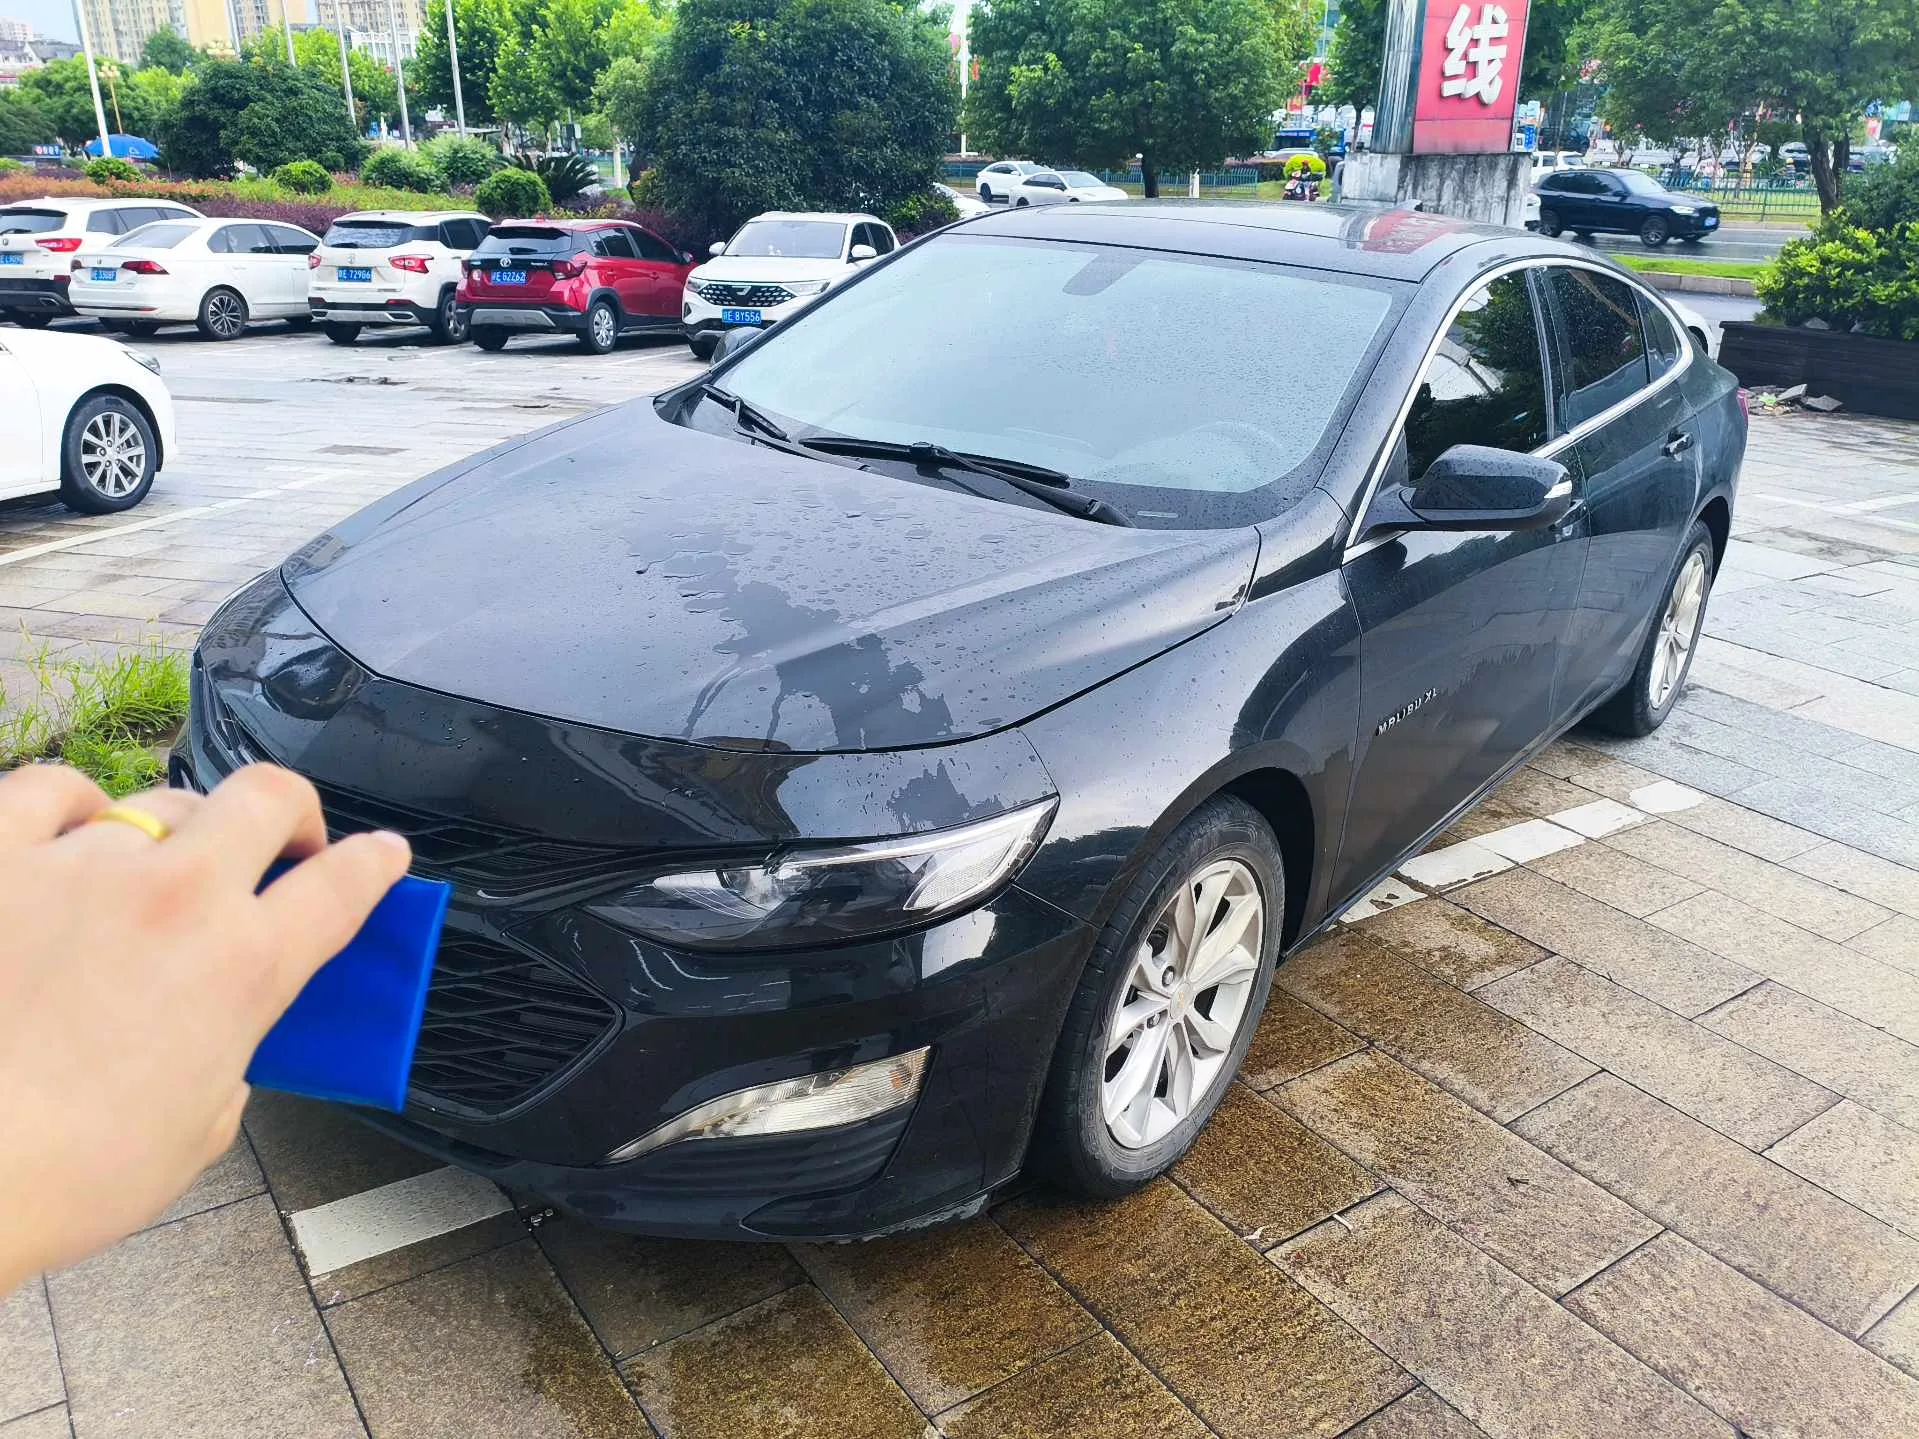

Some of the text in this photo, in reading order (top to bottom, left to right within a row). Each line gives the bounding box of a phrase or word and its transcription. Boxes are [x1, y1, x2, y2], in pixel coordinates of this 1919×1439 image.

[1441, 3, 1509, 106] 线
[1378, 688, 1438, 735] MALIBU XL
